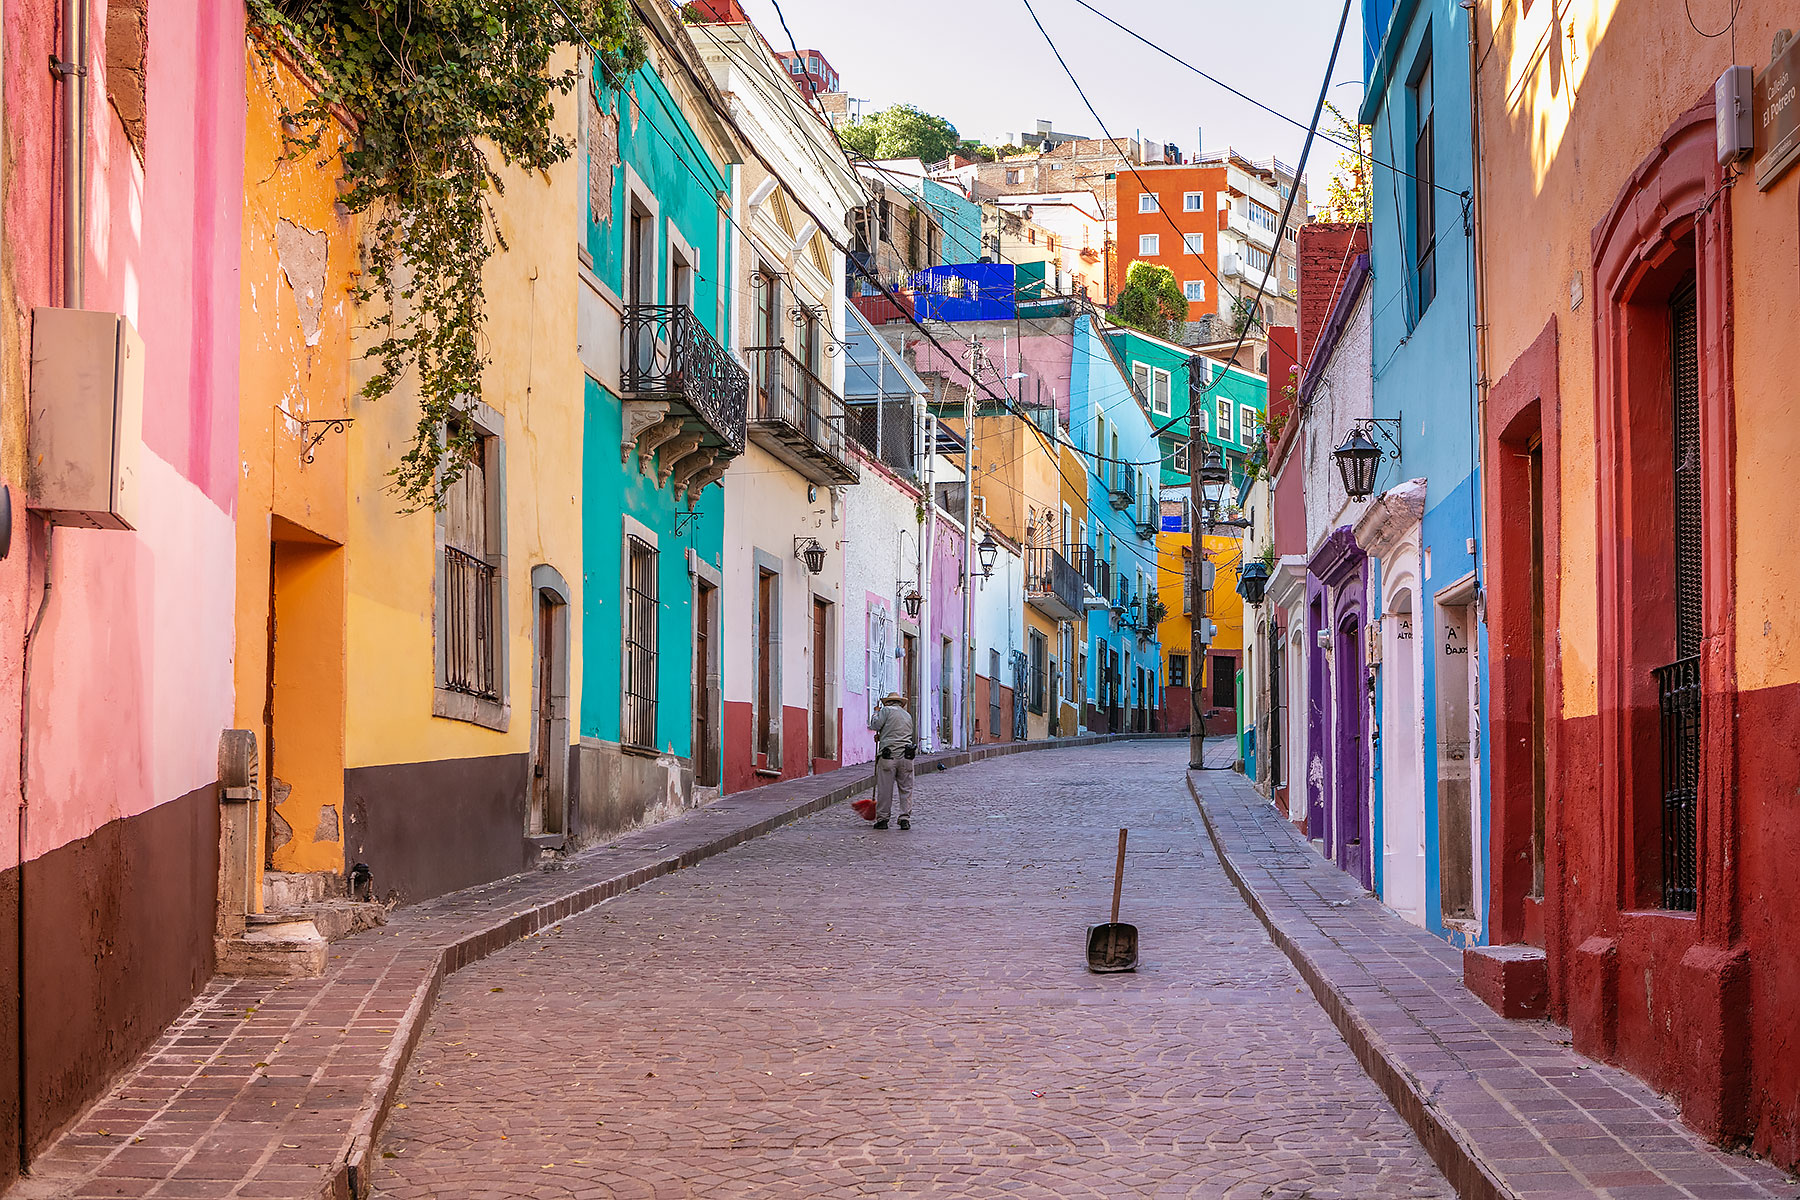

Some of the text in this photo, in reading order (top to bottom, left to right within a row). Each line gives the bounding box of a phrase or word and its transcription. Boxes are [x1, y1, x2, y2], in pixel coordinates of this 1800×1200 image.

[1767, 72, 1789, 100] Callejón
[1763, 86, 1795, 129] El Potrero
